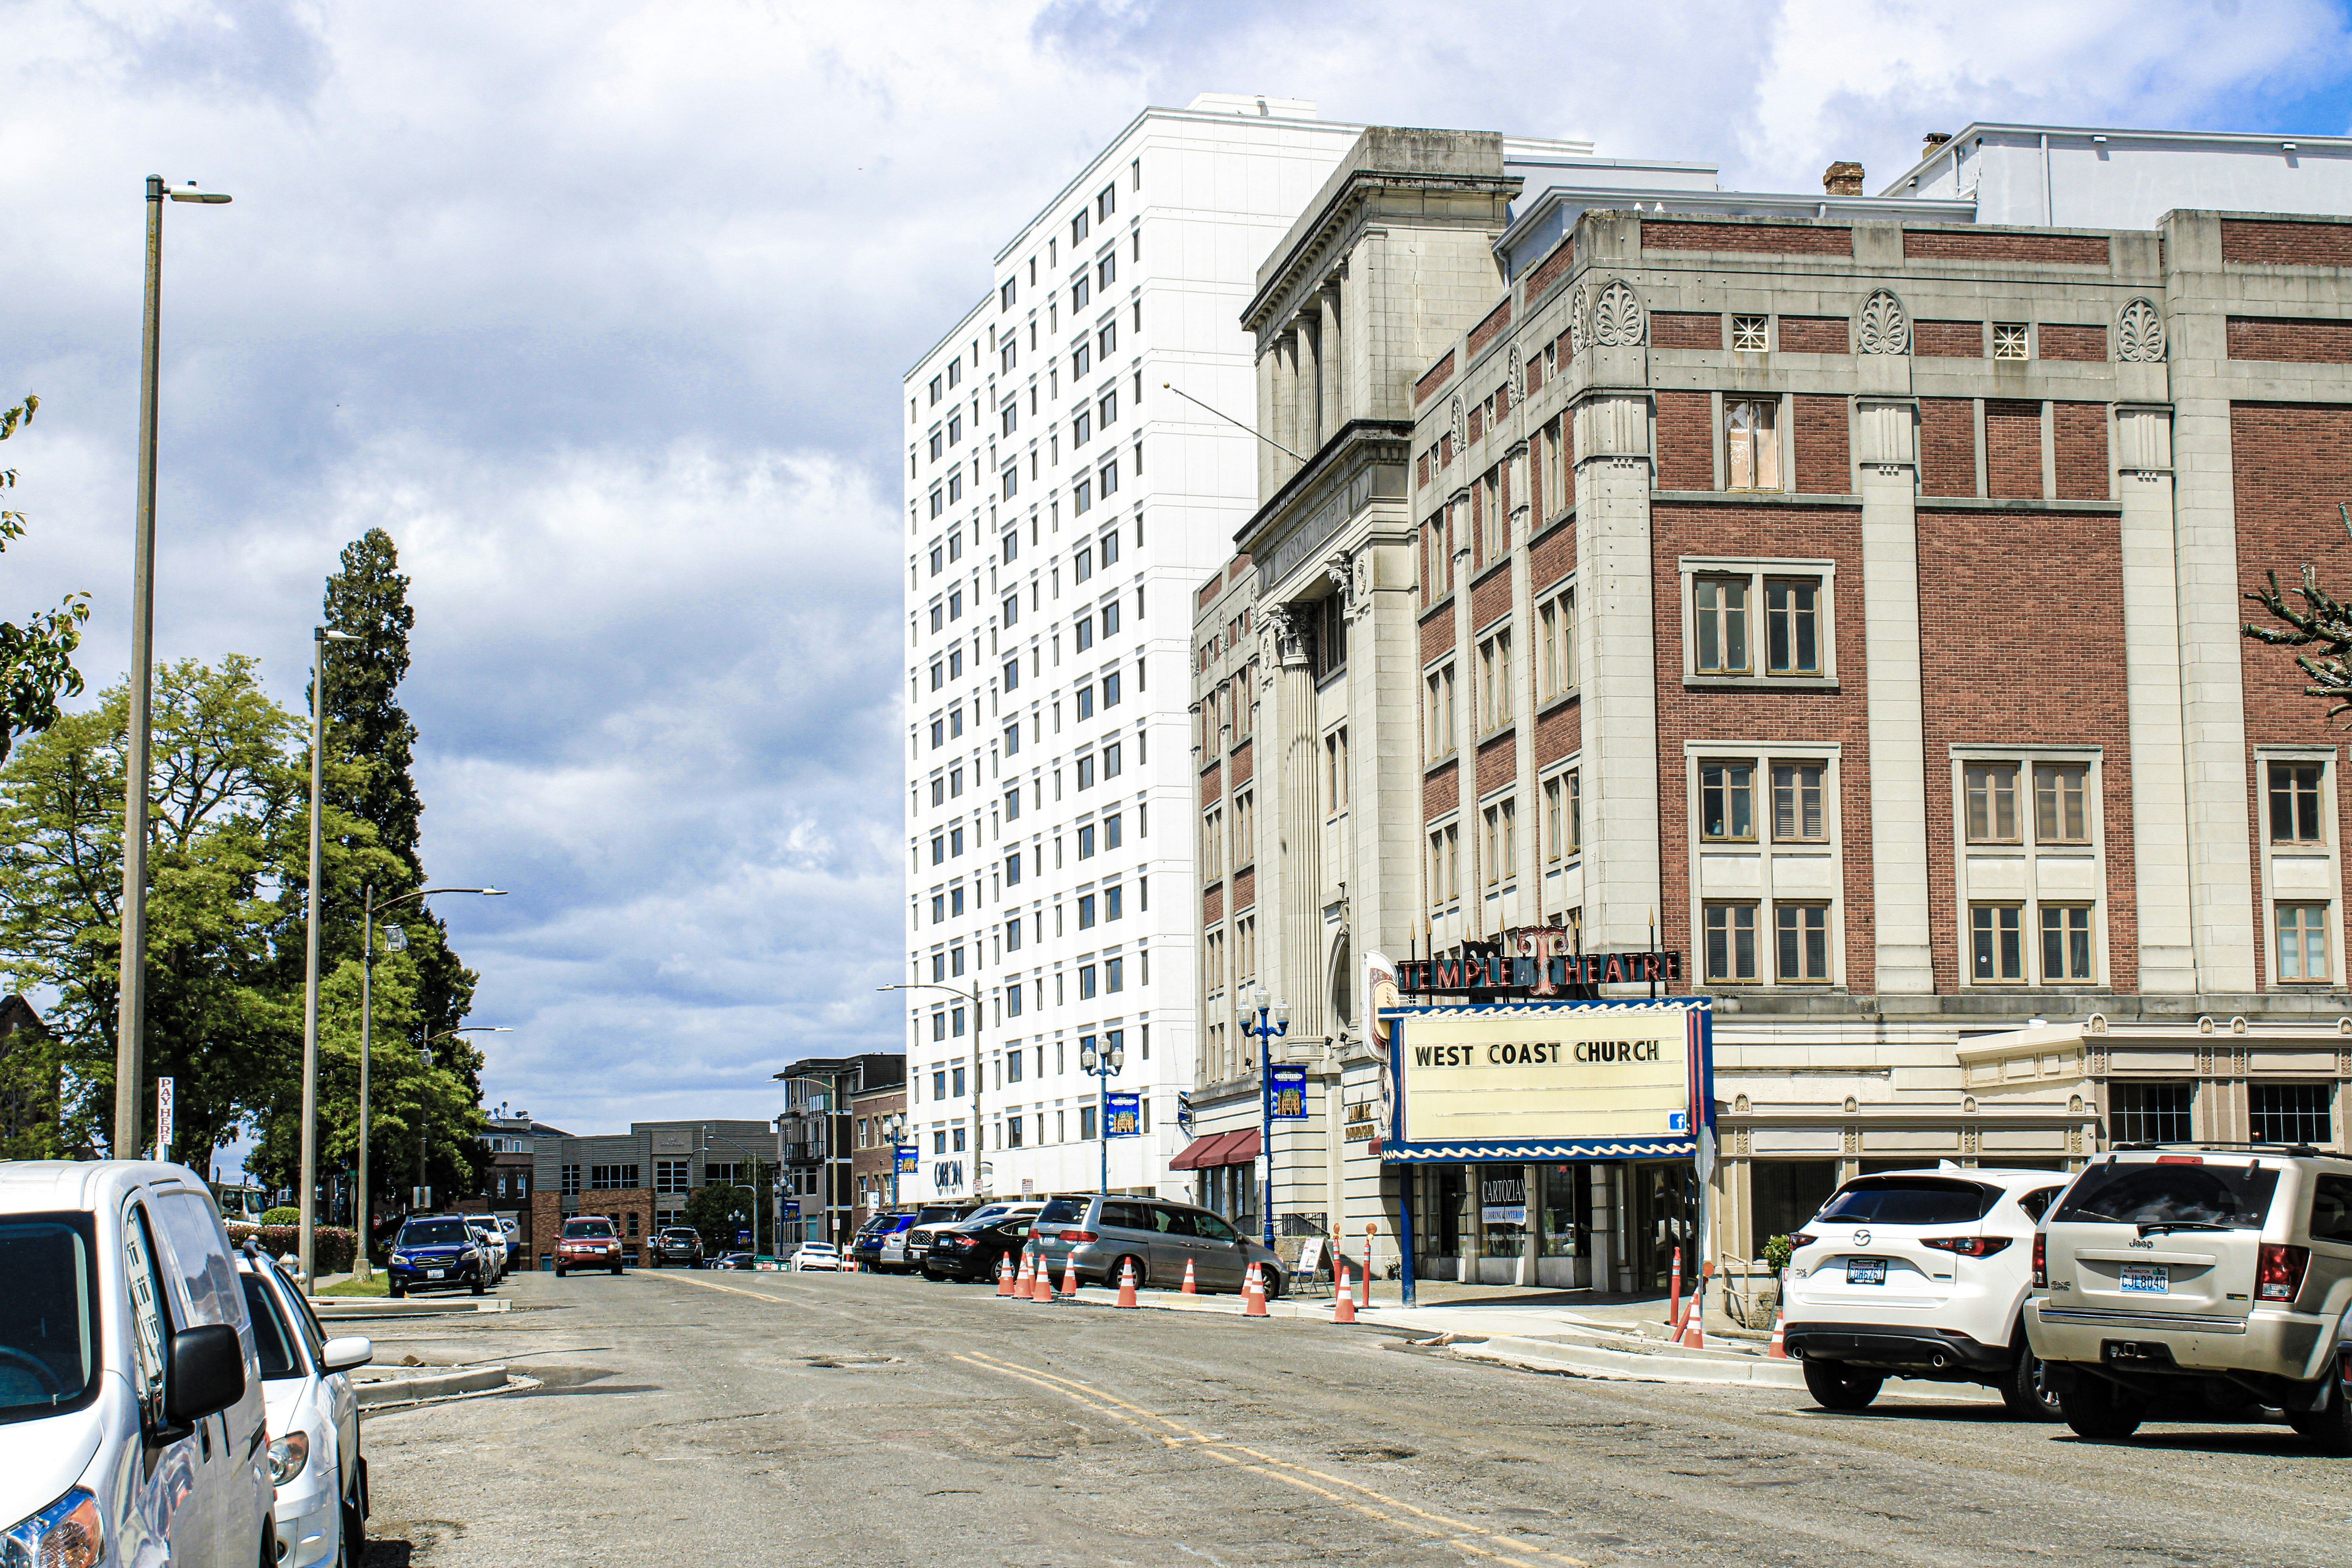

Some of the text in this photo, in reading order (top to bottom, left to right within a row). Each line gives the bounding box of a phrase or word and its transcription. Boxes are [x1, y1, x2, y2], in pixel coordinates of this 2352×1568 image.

[1280, 495, 1345, 573] MASONIC TEMPLE
[1397, 955, 1514, 989] TEMPLE
[1415, 1040, 1659, 1066] WEST COAST CHURCH
[160, 1079, 172, 1105] PAY
[160, 1108, 171, 1142] HERE
[1483, 1211, 1501, 1219] FLOORING
[2129, 1238, 2153, 1249] Jeep
[2122, 1274, 2165, 1289] CJL8040
